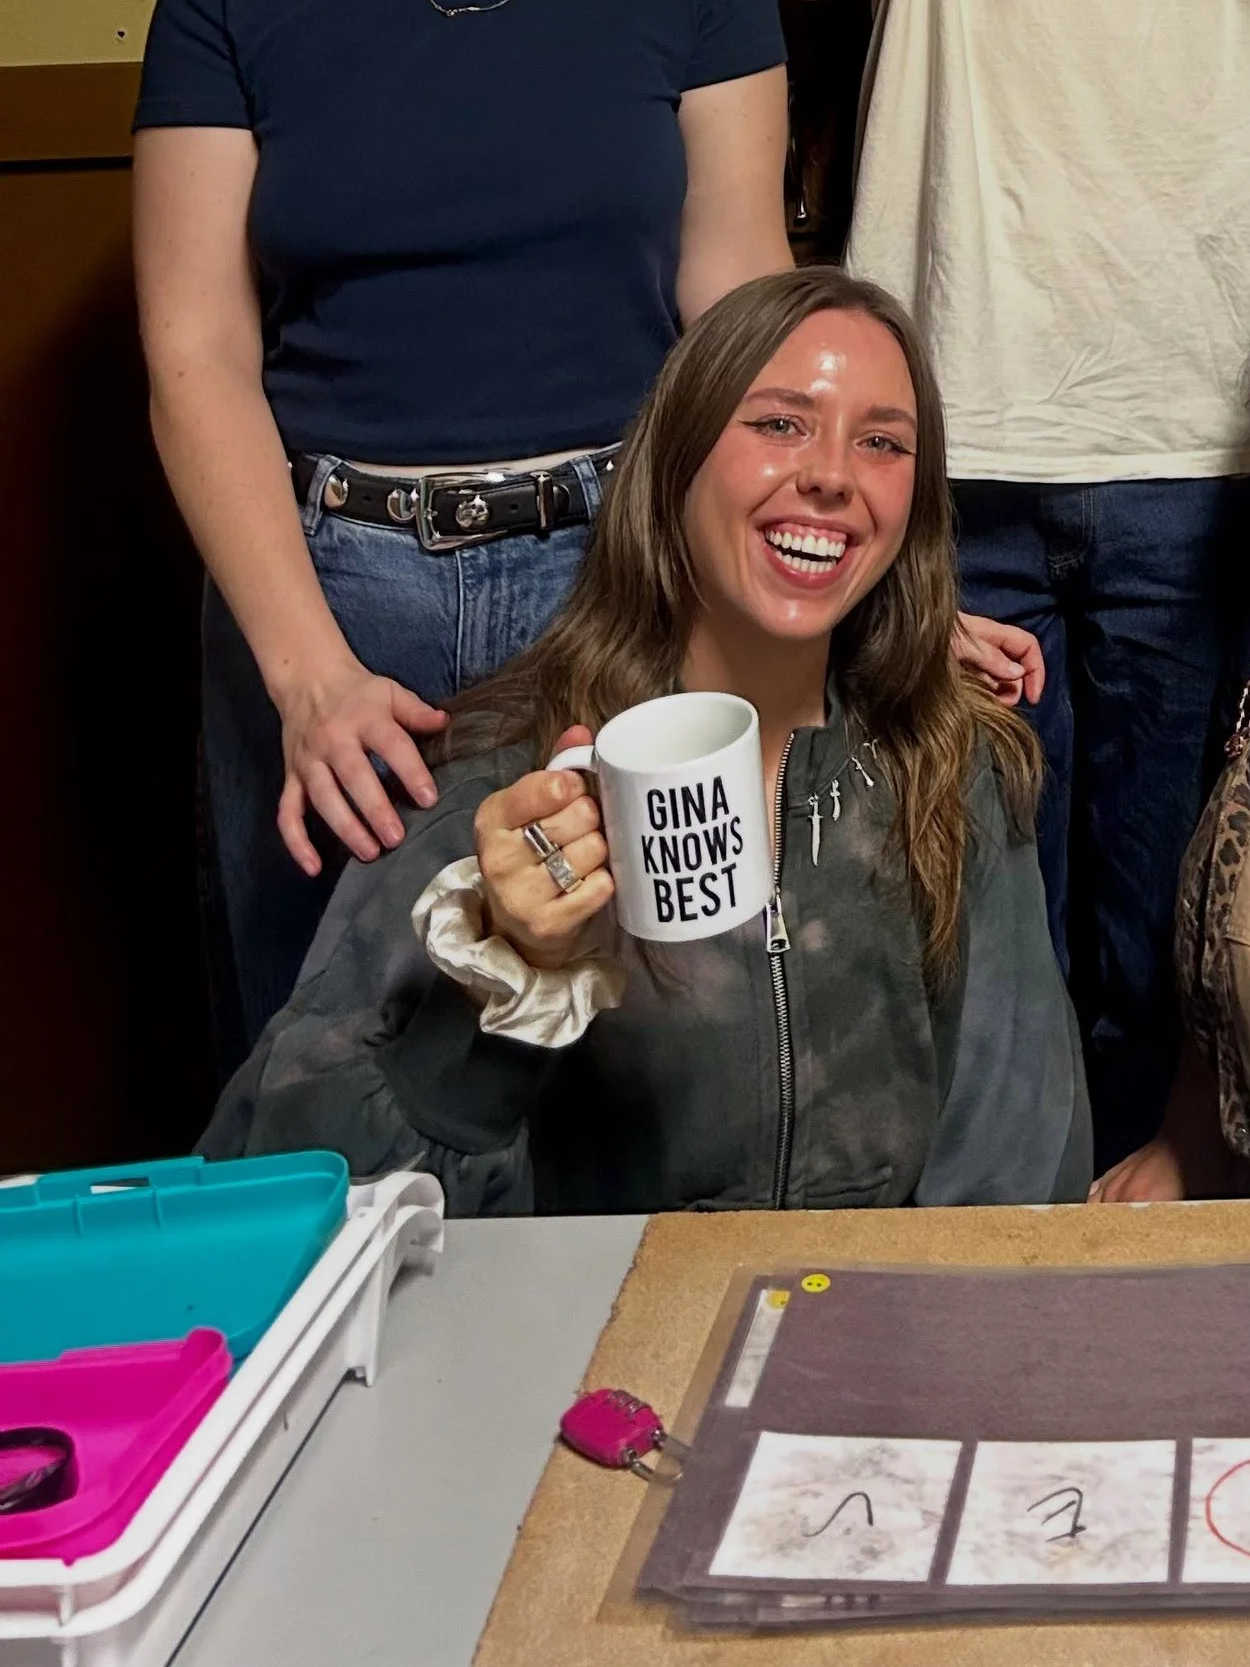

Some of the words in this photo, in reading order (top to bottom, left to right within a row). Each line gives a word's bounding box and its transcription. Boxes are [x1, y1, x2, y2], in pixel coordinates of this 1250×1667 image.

[647, 776, 730, 831] GINA
[641, 816, 744, 874] KNOWS
[653, 862, 737, 923] BEST
